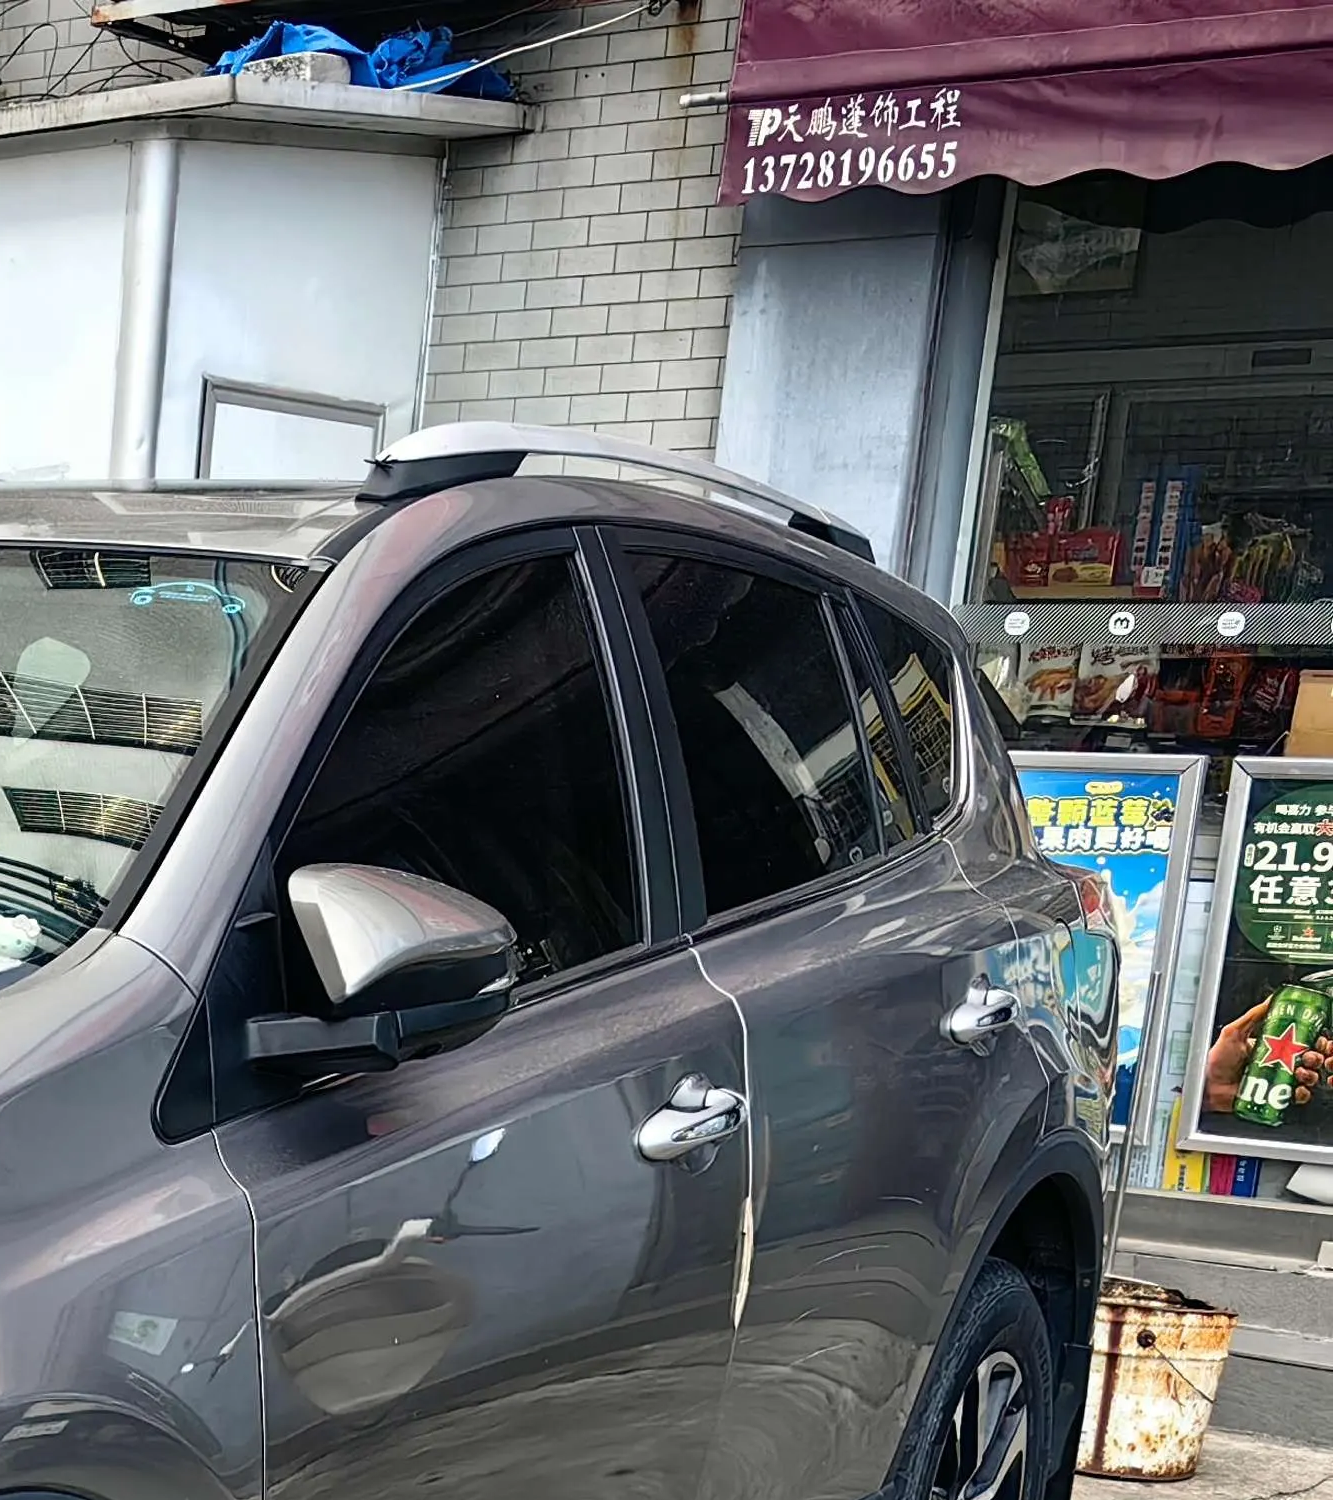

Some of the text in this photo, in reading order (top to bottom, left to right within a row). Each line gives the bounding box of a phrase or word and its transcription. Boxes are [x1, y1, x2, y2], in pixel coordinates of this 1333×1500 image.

[741, 141, 958, 194] 13728196655
[1035, 826, 1171, 850] 果肉更好喝
